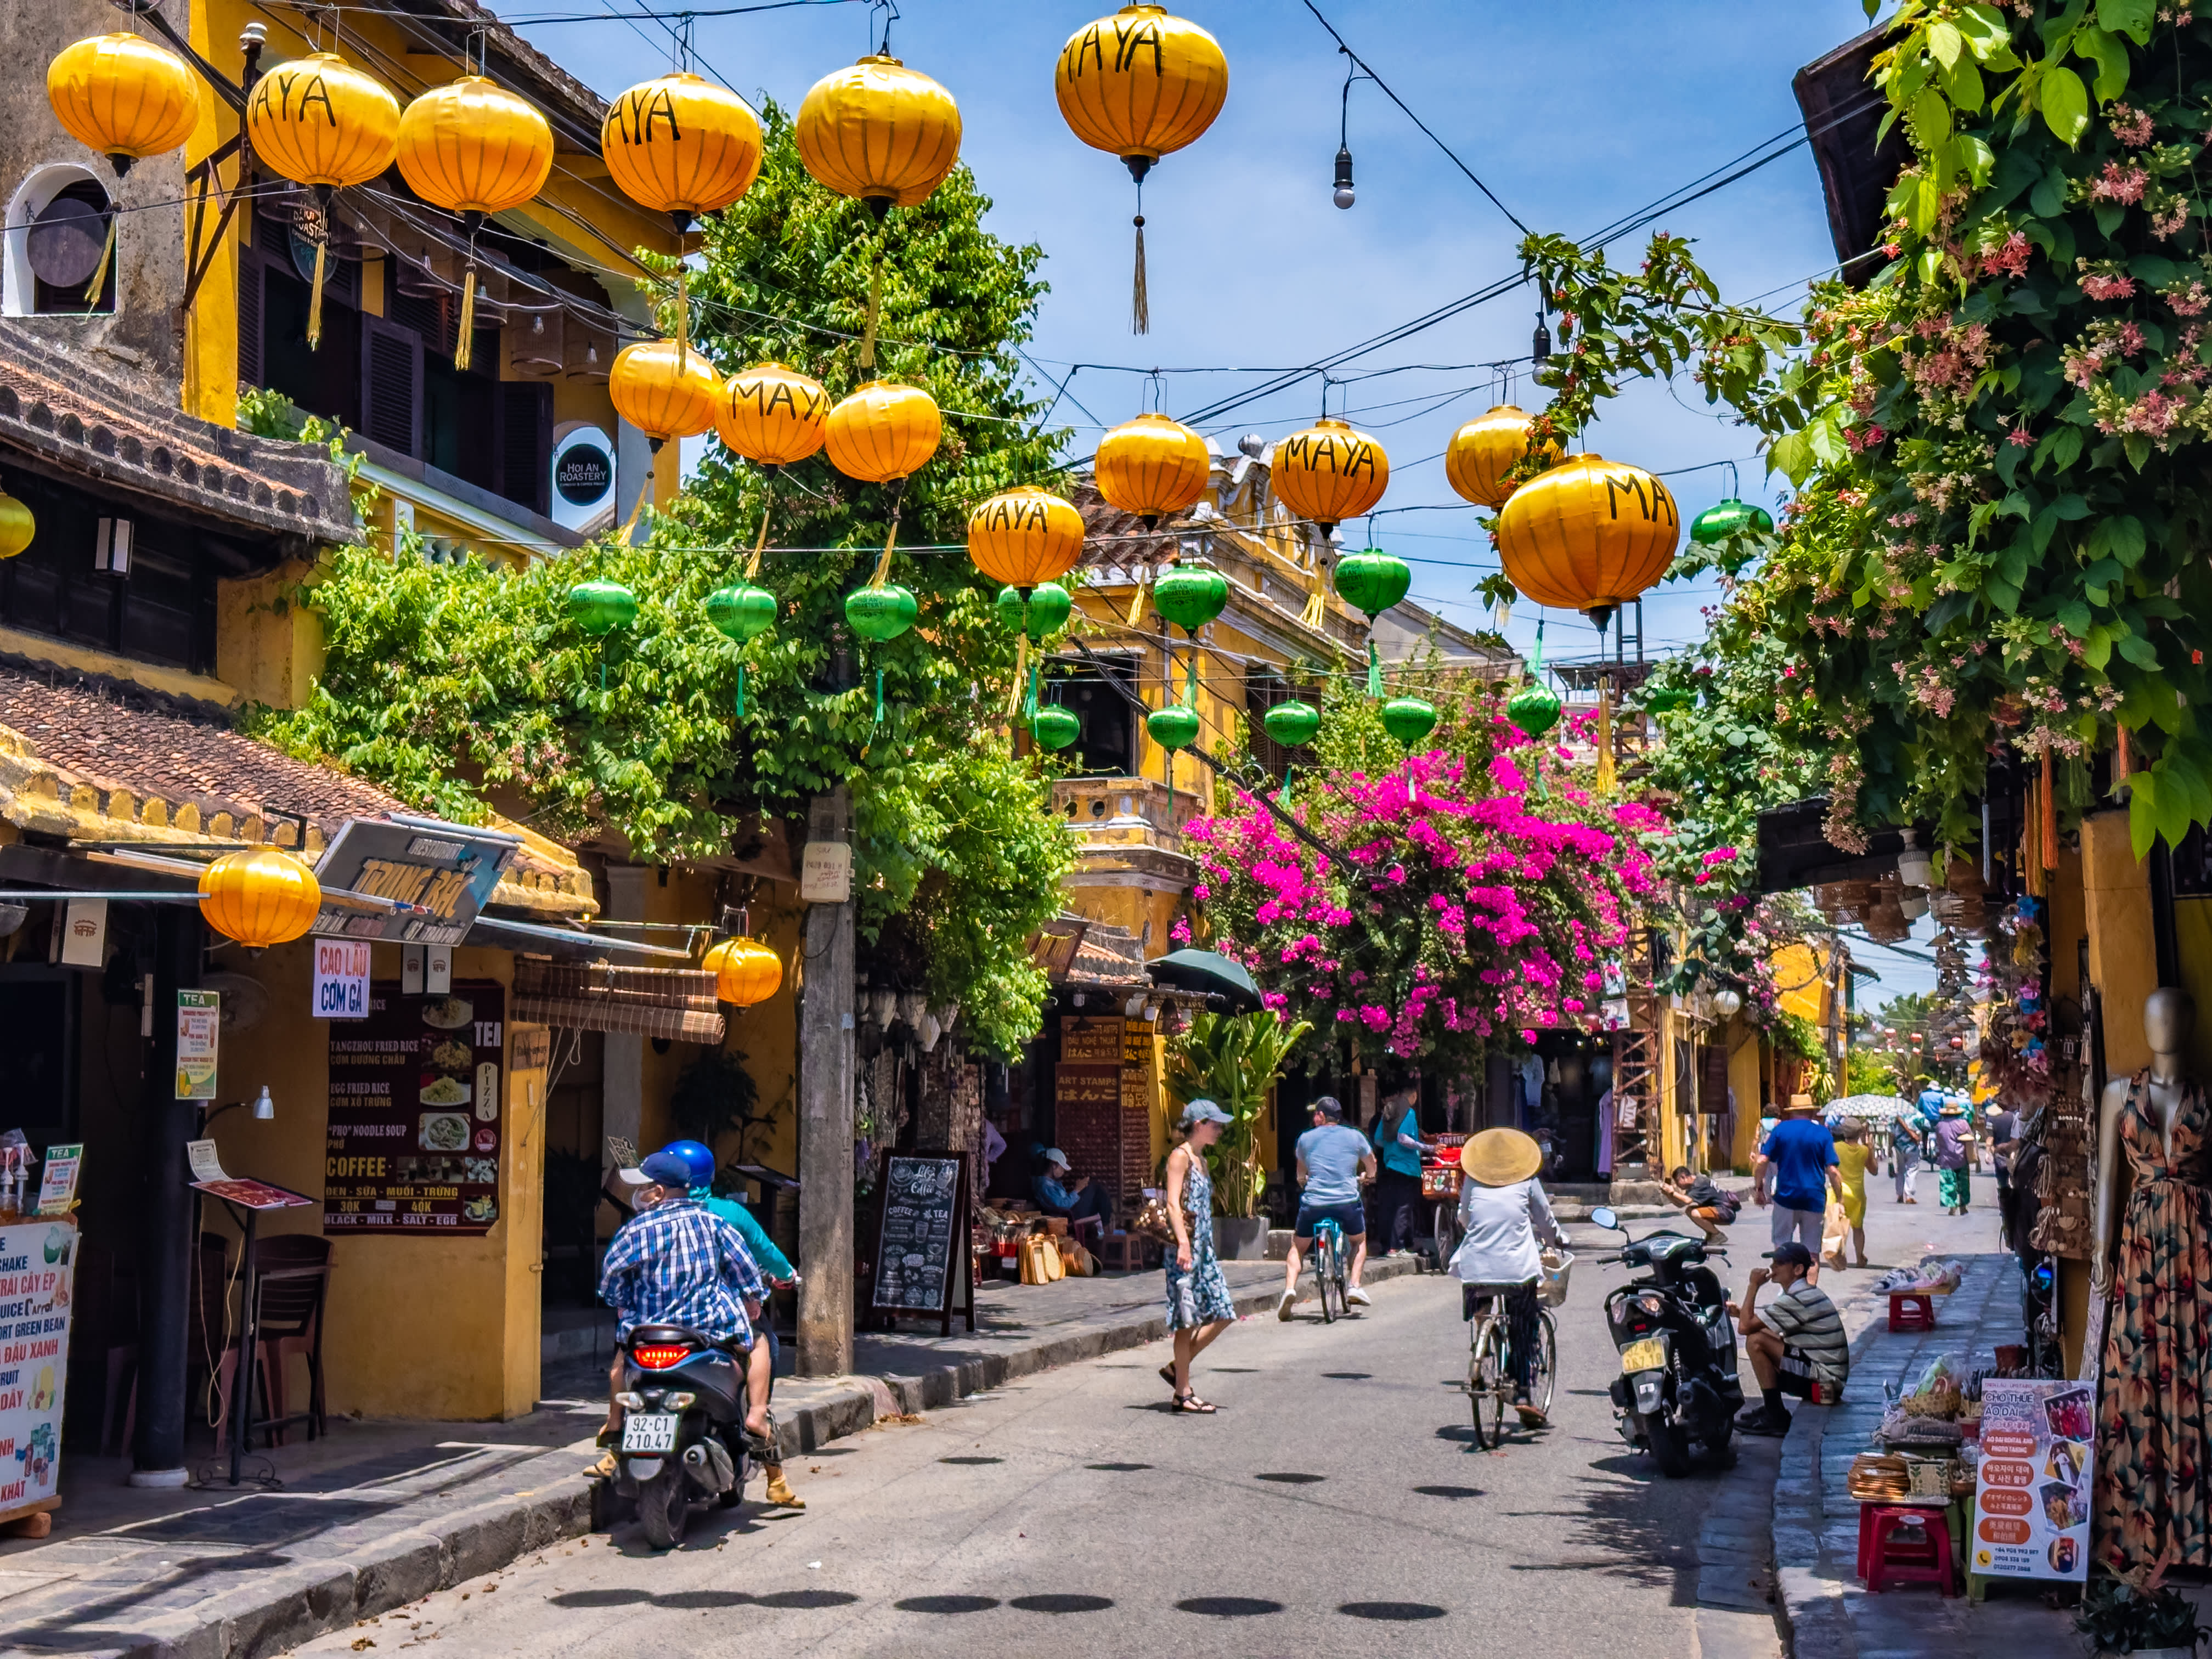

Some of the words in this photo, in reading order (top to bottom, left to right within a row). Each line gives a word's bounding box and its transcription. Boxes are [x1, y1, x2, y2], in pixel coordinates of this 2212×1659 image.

[1284, 435, 1375, 484] MAYA
[567, 463, 583, 473] HOI
[585, 463, 600, 473] AN
[560, 470, 607, 482] ROASTERY
[972, 500, 1047, 534] MAYA
[320, 946, 342, 975] CAO
[183, 994, 206, 1006] TEA
[321, 978, 346, 1012] CƠM
[348, 978, 363, 1013] GÀ
[330, 1040, 374, 1052] YANGZHOU
[375, 1040, 399, 1052] FRIED
[400, 1040, 419, 1052] RICE
[382, 1052, 406, 1065] CHÂU
[1067, 1048, 1092, 1058] はんこ
[1058, 1076, 1077, 1085] ART
[1080, 1076, 1118, 1086] STAMPS
[330, 1083, 346, 1094] EGG
[347, 1082, 370, 1094] FRIED
[371, 1082, 391, 1094] RICE
[482, 1065, 492, 1119] PIZZA
[1057, 1088, 1118, 1101] はんこ
[353, 1125, 385, 1137] NOODLE
[386, 1125, 407, 1137] SOUP
[1438, 1136, 1465, 1146] COFFEE
[52, 1148, 70, 1159] TEA
[326, 1156, 386, 1177] COFFEE
[340, 1200, 360, 1212] 30K
[411, 1200, 432, 1212] 40K
[888, 1206, 913, 1216] COFFEE
[933, 1209, 948, 1219] TEA
[324, 1215, 358, 1225] BLACK
[367, 1215, 393, 1225] MILK
[402, 1215, 428, 1225] SALT
[436, 1215, 458, 1225] EGG
[21, 1270, 41, 1294] CÂY
[42, 1269, 56, 1291] ÉP
[15, 1319, 42, 1338] GREEN
[43, 1316, 66, 1334] BEAN
[4, 1341, 27, 1366] ĐẬU
[29, 1338, 59, 1359] XANH
[0, 1388, 24, 1411] DÂY
[1985, 1392, 2006, 1402] CHO
[1985, 1403, 2001, 1417] ÁO
[625, 1434, 672, 1449] 210.47
[0, 1478, 26, 1502] KHÁT
